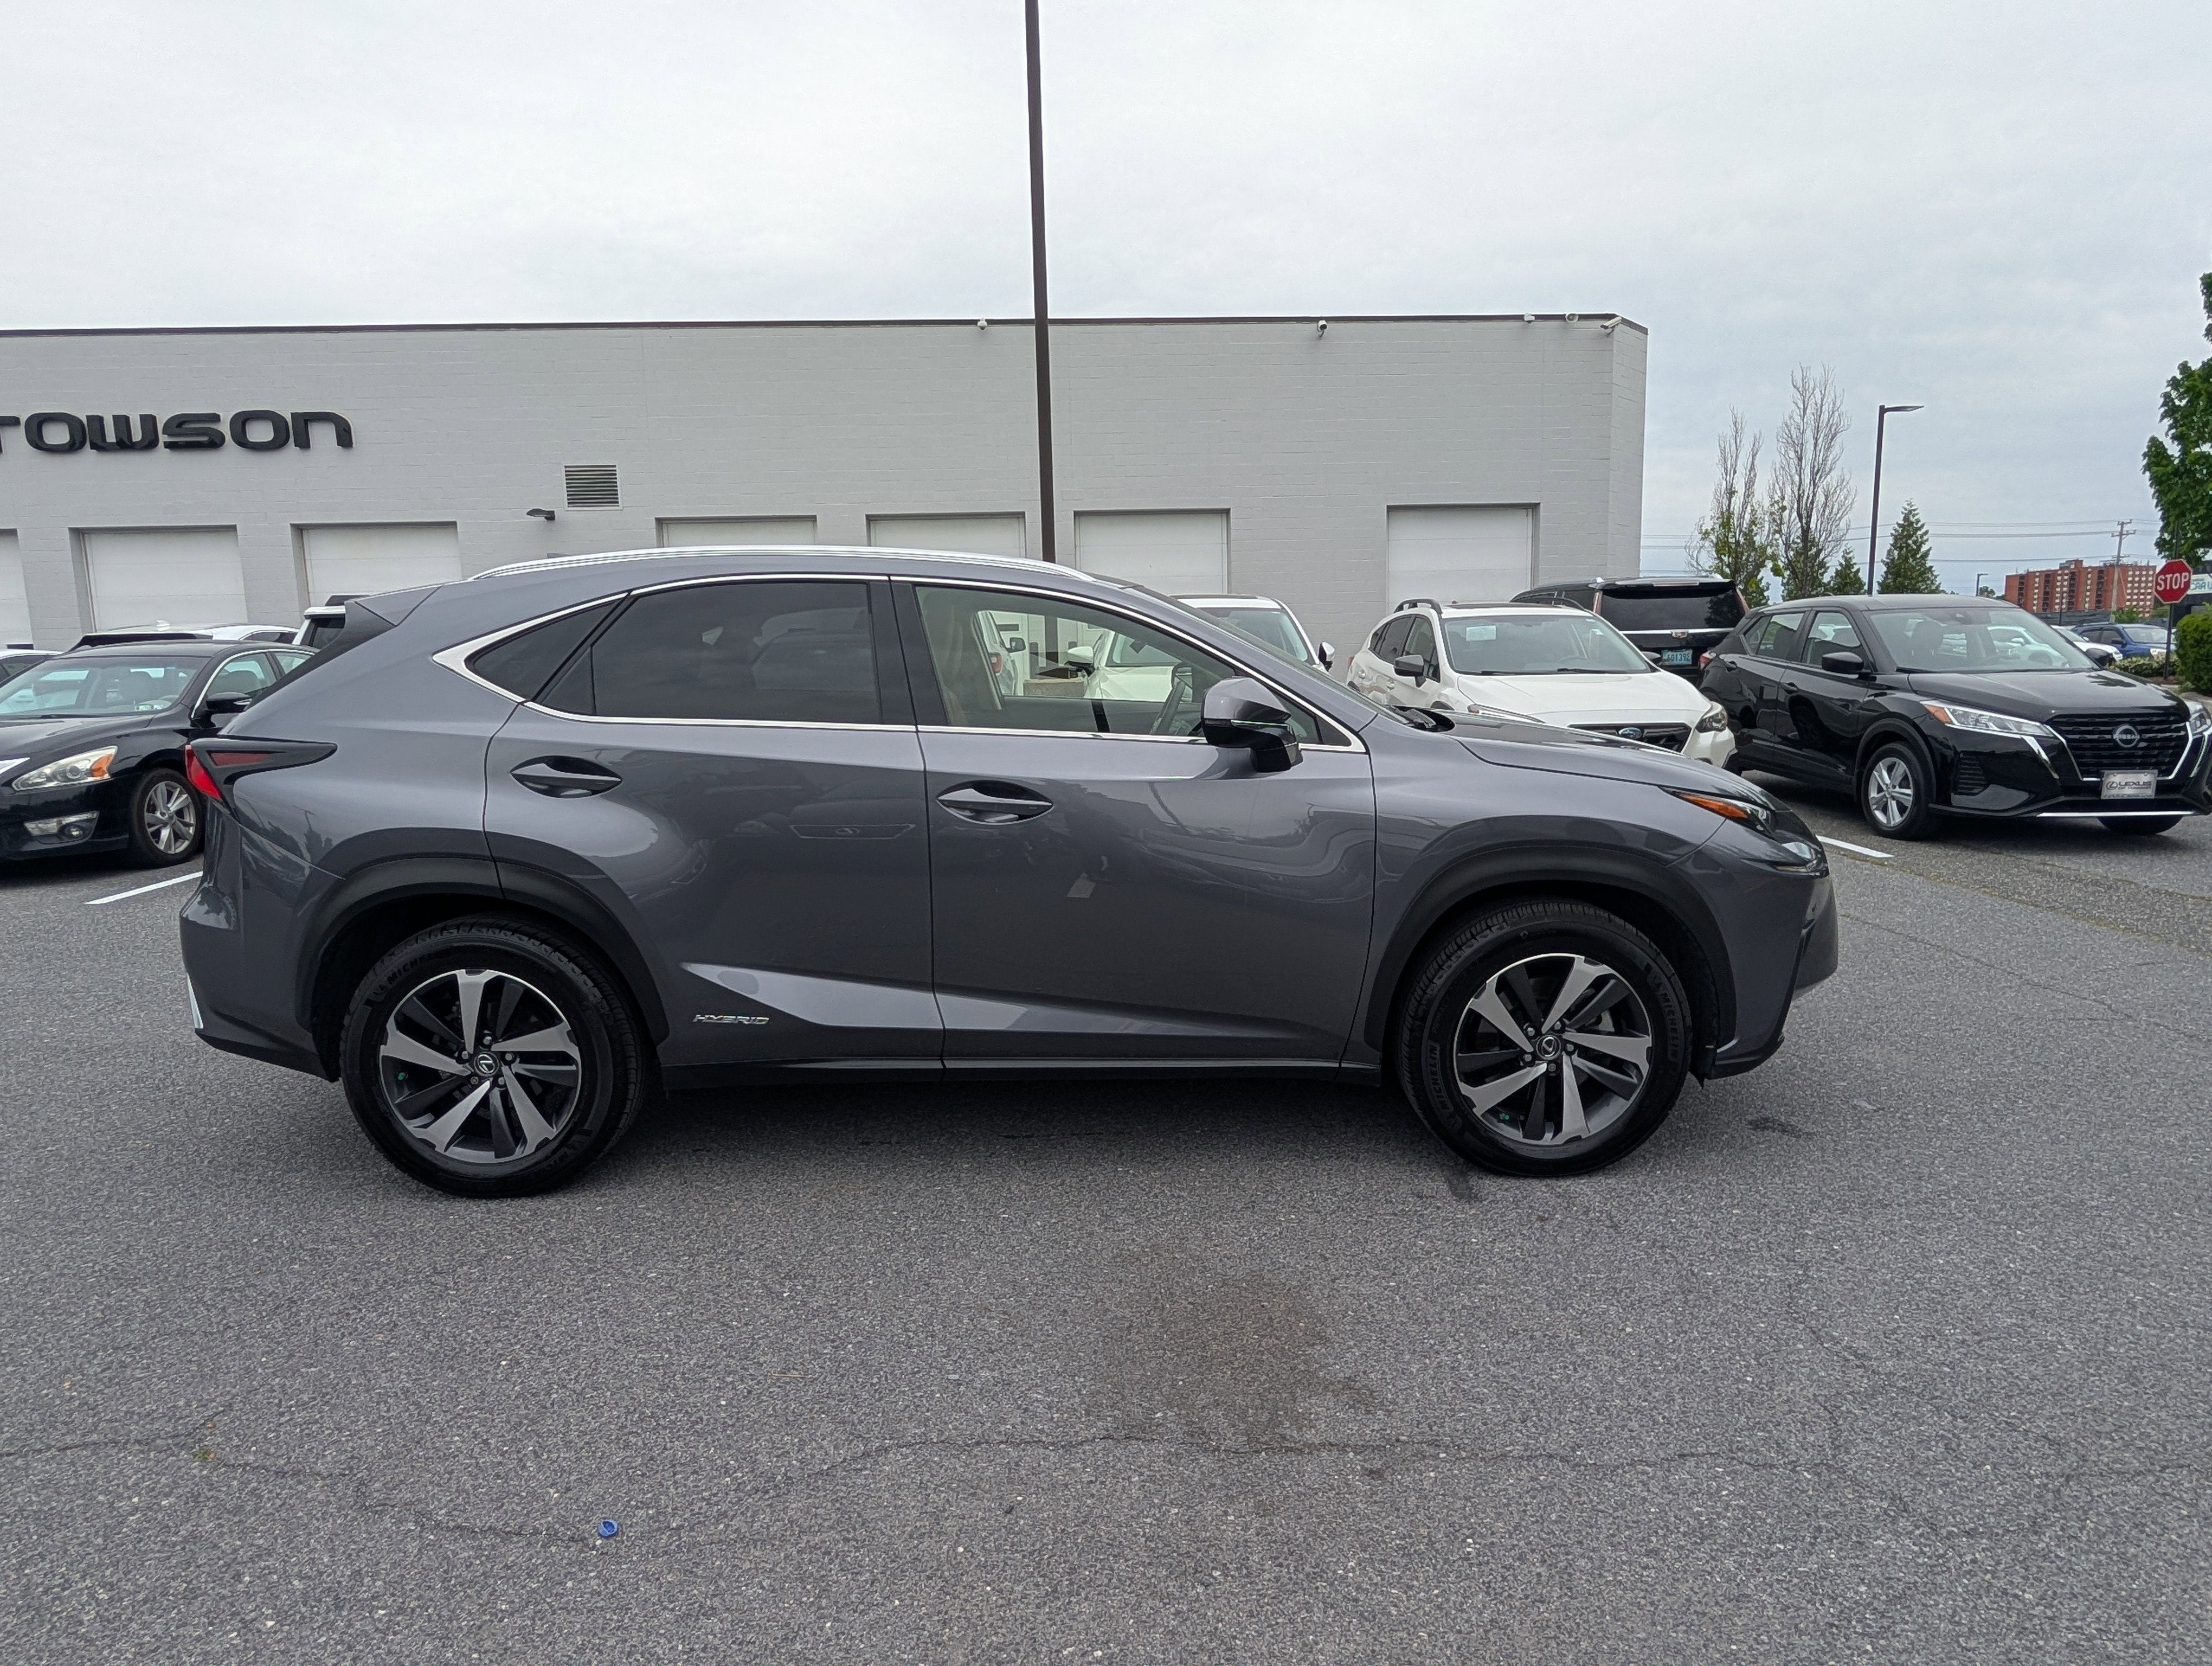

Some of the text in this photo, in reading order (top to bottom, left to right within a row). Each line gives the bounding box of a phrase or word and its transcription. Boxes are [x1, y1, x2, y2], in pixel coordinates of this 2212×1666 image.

[2157, 572, 2189, 591] STOP
[692, 1015, 769, 1024] HYBRID
[1659, 992, 1679, 1059] MICHELIN
[1428, 1046, 1450, 1112] MICHELIN
